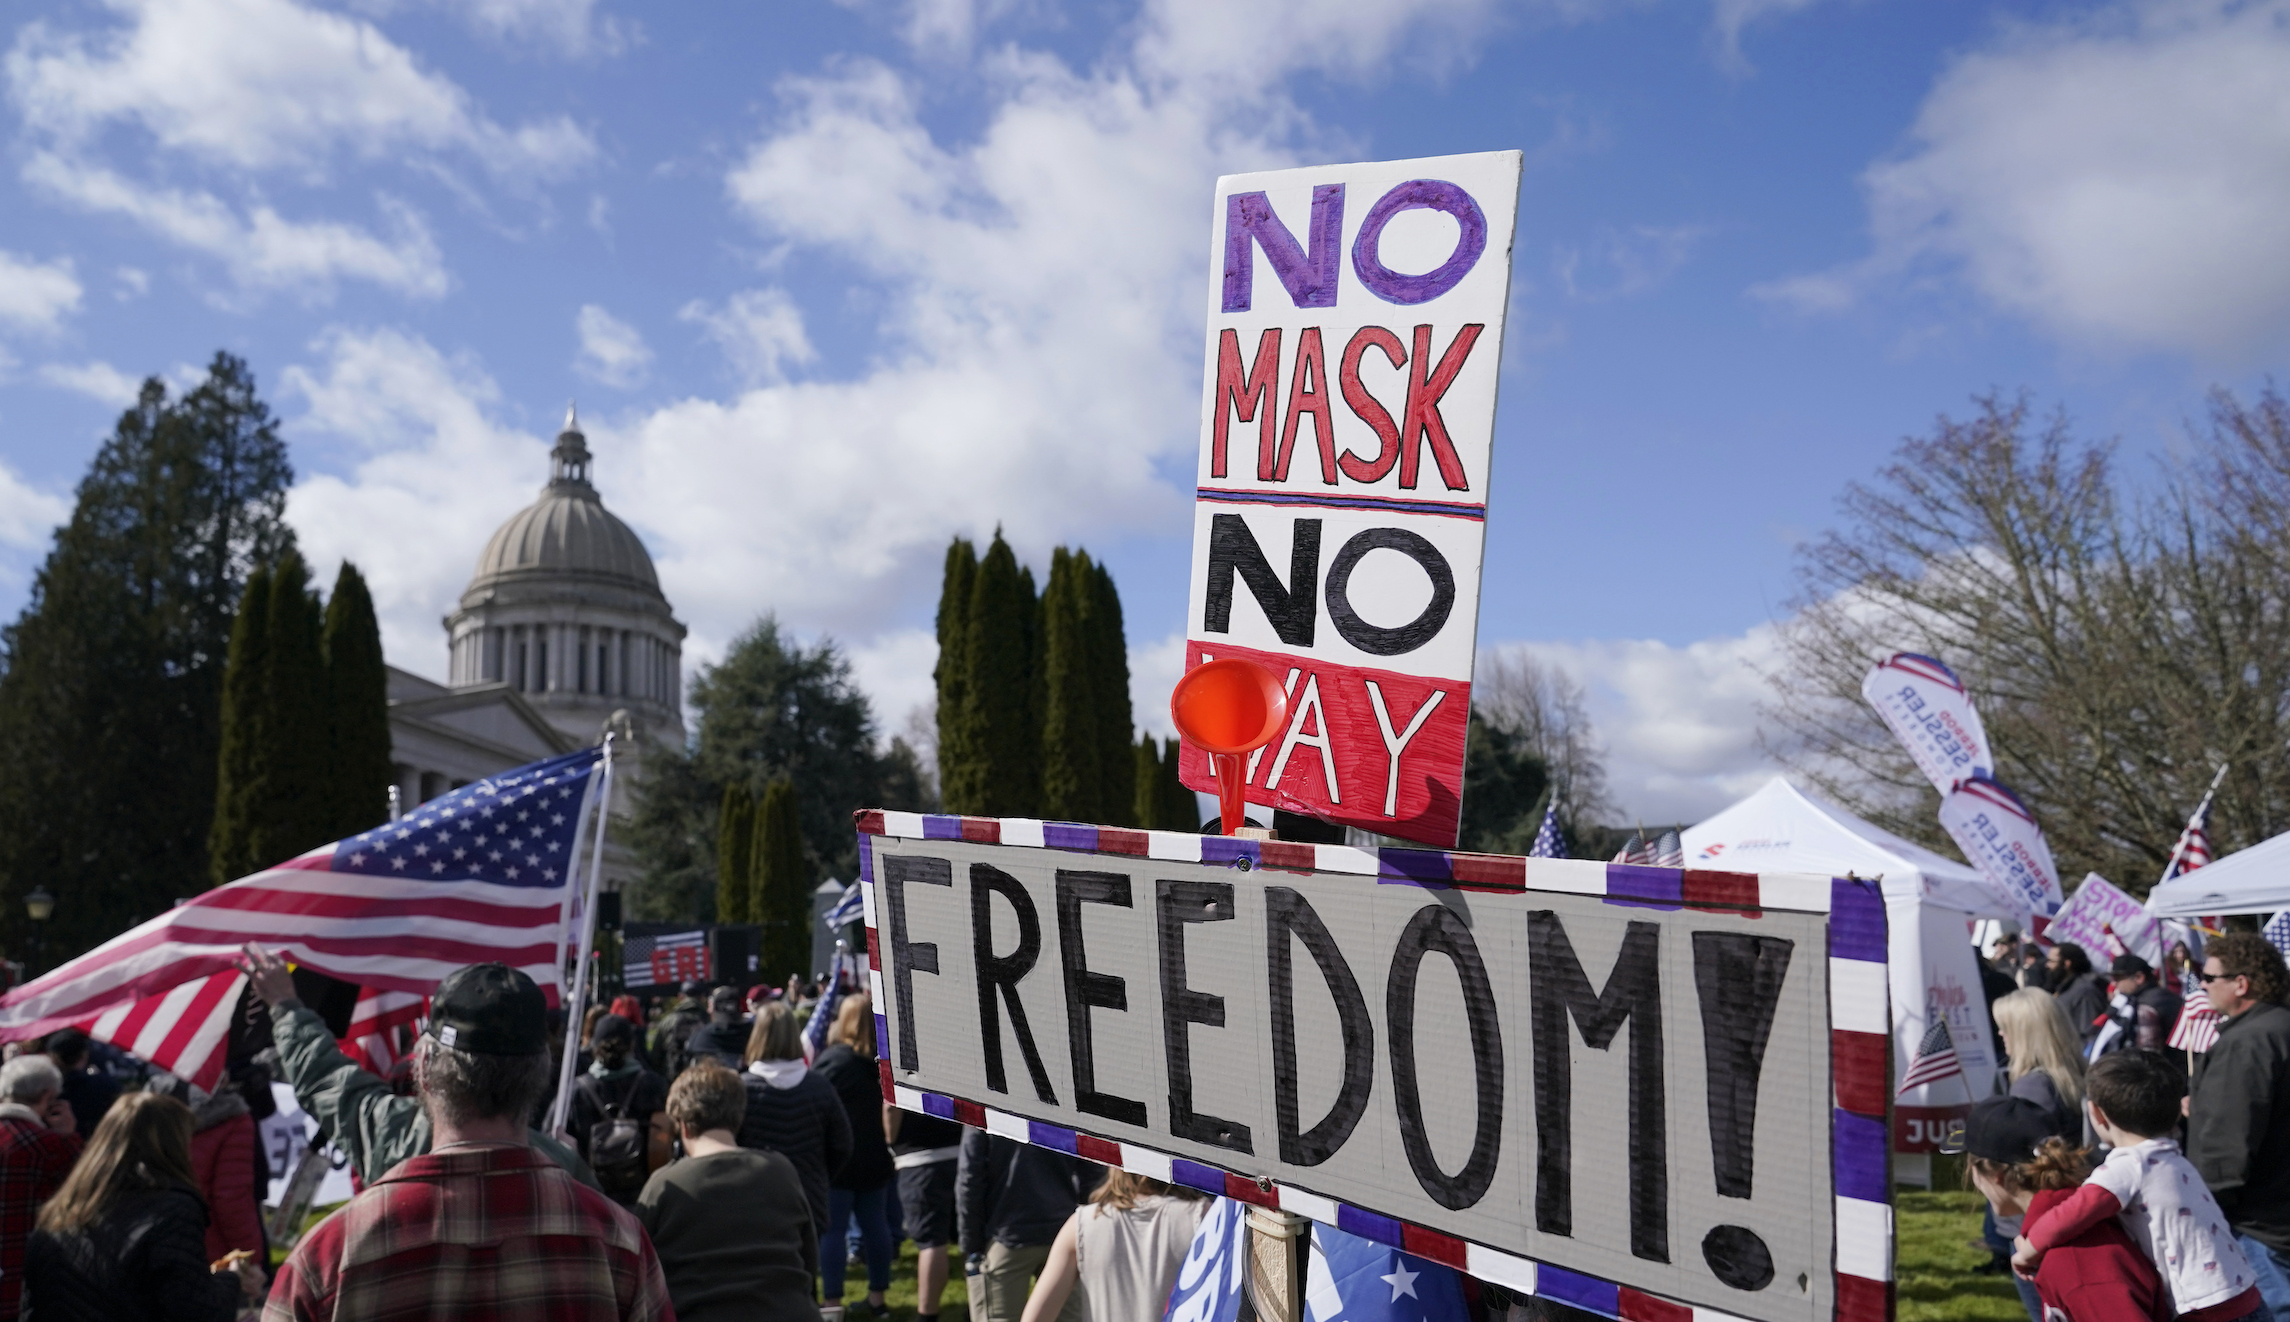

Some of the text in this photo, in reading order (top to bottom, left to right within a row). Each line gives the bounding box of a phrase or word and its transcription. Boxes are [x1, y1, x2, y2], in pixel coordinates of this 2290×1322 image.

[1221, 178, 1488, 313] NO
[1211, 323, 1485, 491] MASK
[1204, 513, 1456, 656] NO
[2086, 881, 2142, 922] STOP
[882, 854, 1795, 1292] FREEDOM!
